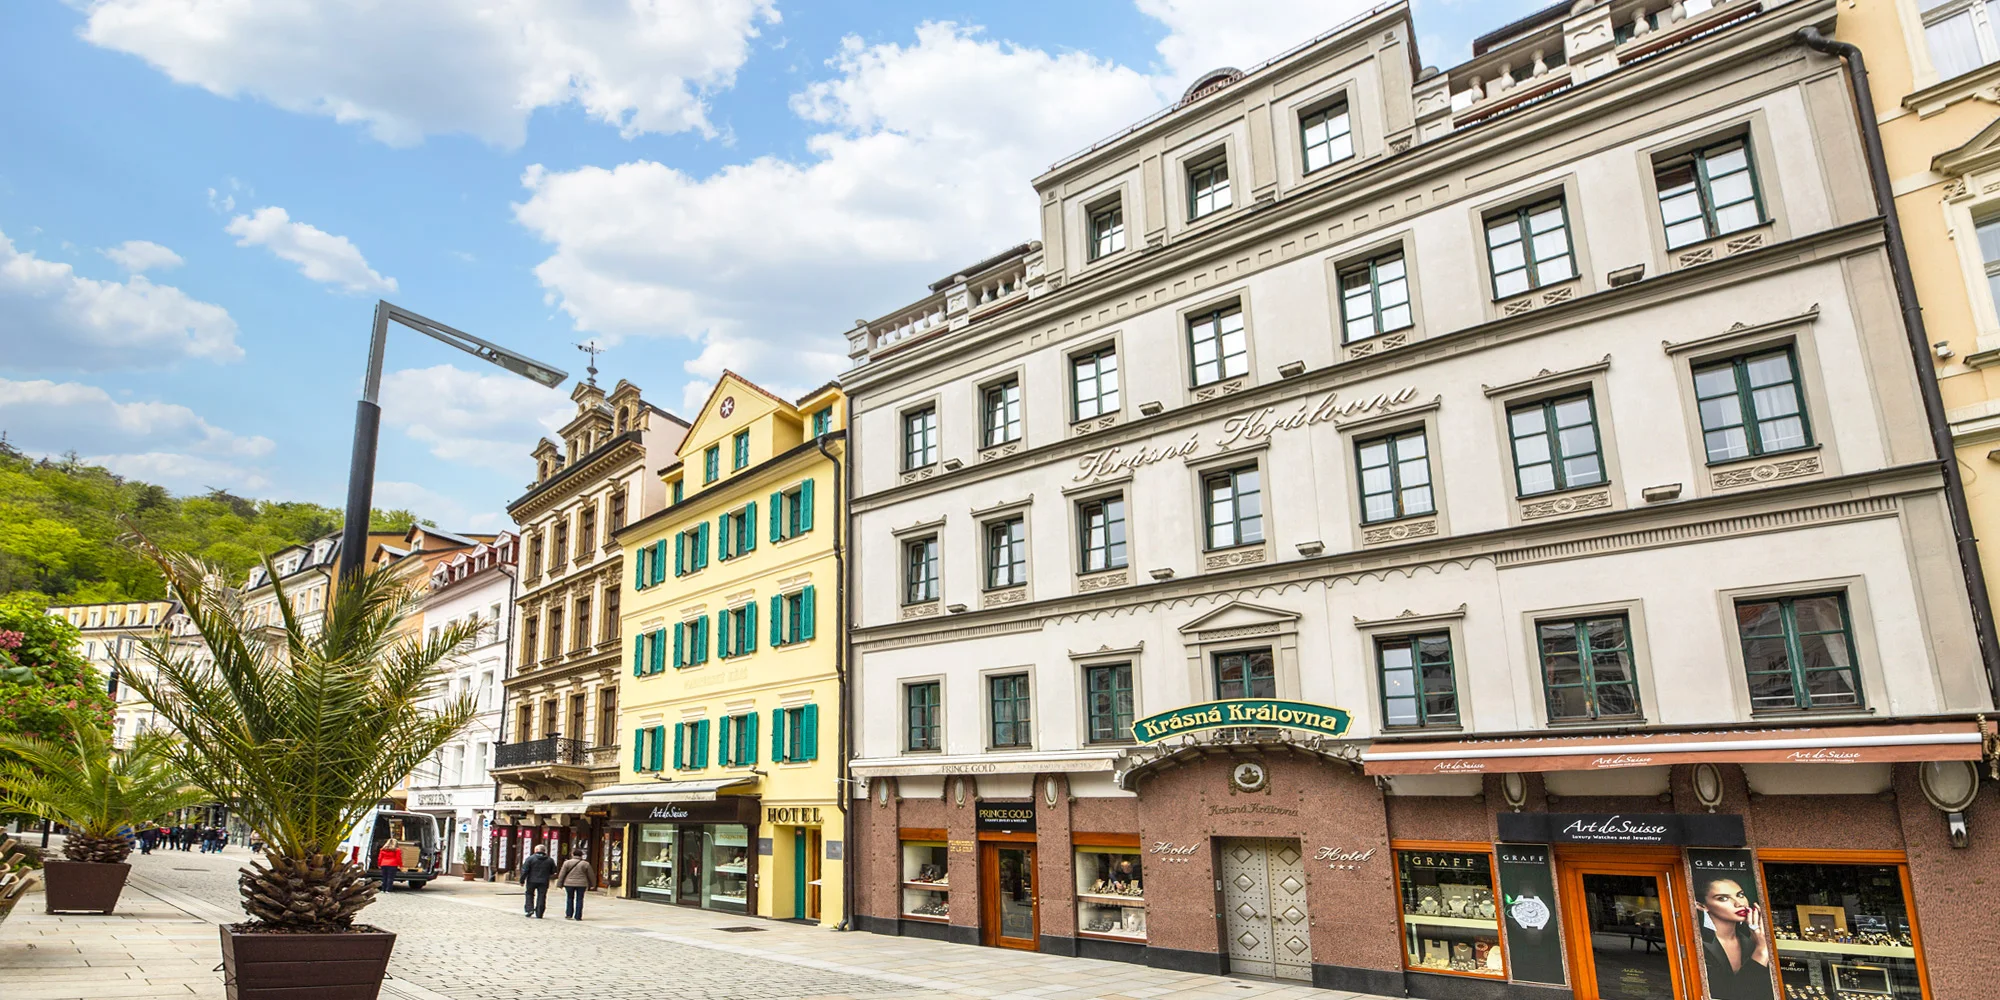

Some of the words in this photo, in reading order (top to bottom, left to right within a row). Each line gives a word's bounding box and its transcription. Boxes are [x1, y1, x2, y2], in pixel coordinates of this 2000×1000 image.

[1072, 432, 1199, 482] Krásná
[1216, 385, 1419, 446] Královna
[1143, 706, 1222, 738] Krásná
[1227, 704, 1337, 731] Královna
[941, 764, 968, 774] PRINCE
[971, 763, 996, 773] GOLD
[767, 807, 823, 824] HOTEL
[979, 809, 1008, 819] PRINCE
[1008, 809, 1034, 819] GOLD
[1563, 820, 1598, 834] Art
[1619, 821, 1667, 834] Suisse
[1150, 842, 1200, 856] Hotel
[1314, 846, 1377, 862] Hotel
[1412, 856, 1474, 867] GRAFF
[1695, 860, 1746, 868] GRAFF
